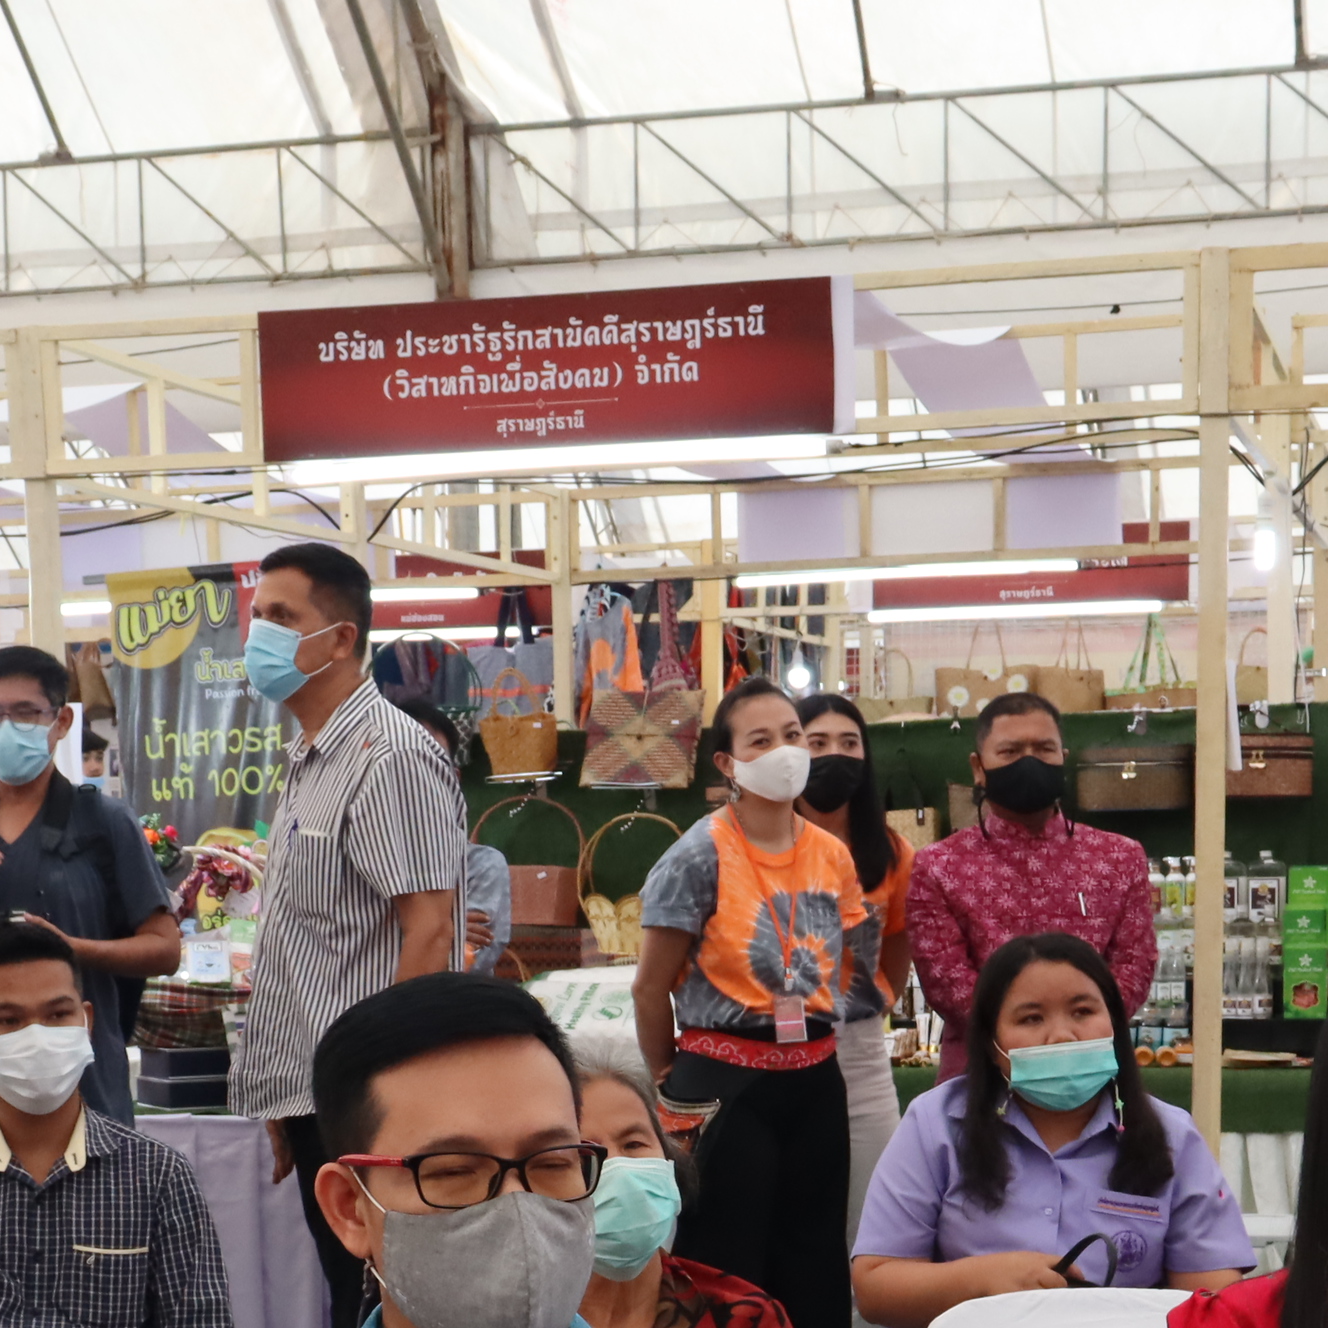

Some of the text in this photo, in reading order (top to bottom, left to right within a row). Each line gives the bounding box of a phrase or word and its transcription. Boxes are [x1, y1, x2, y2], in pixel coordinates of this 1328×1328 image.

[317, 303, 766, 364] บริษัท ประชารัฐรักสามัคคีสุราษฎร์ธานี
[382, 353, 700, 401] (วิสาหกิจเพื่อสังคม) จำกัด
[495, 408, 585, 437] สุราษฎร์ธานี
[145, 718, 283, 759] น้ำเสาวรส
[152, 762, 284, 801] แท้ 100%
